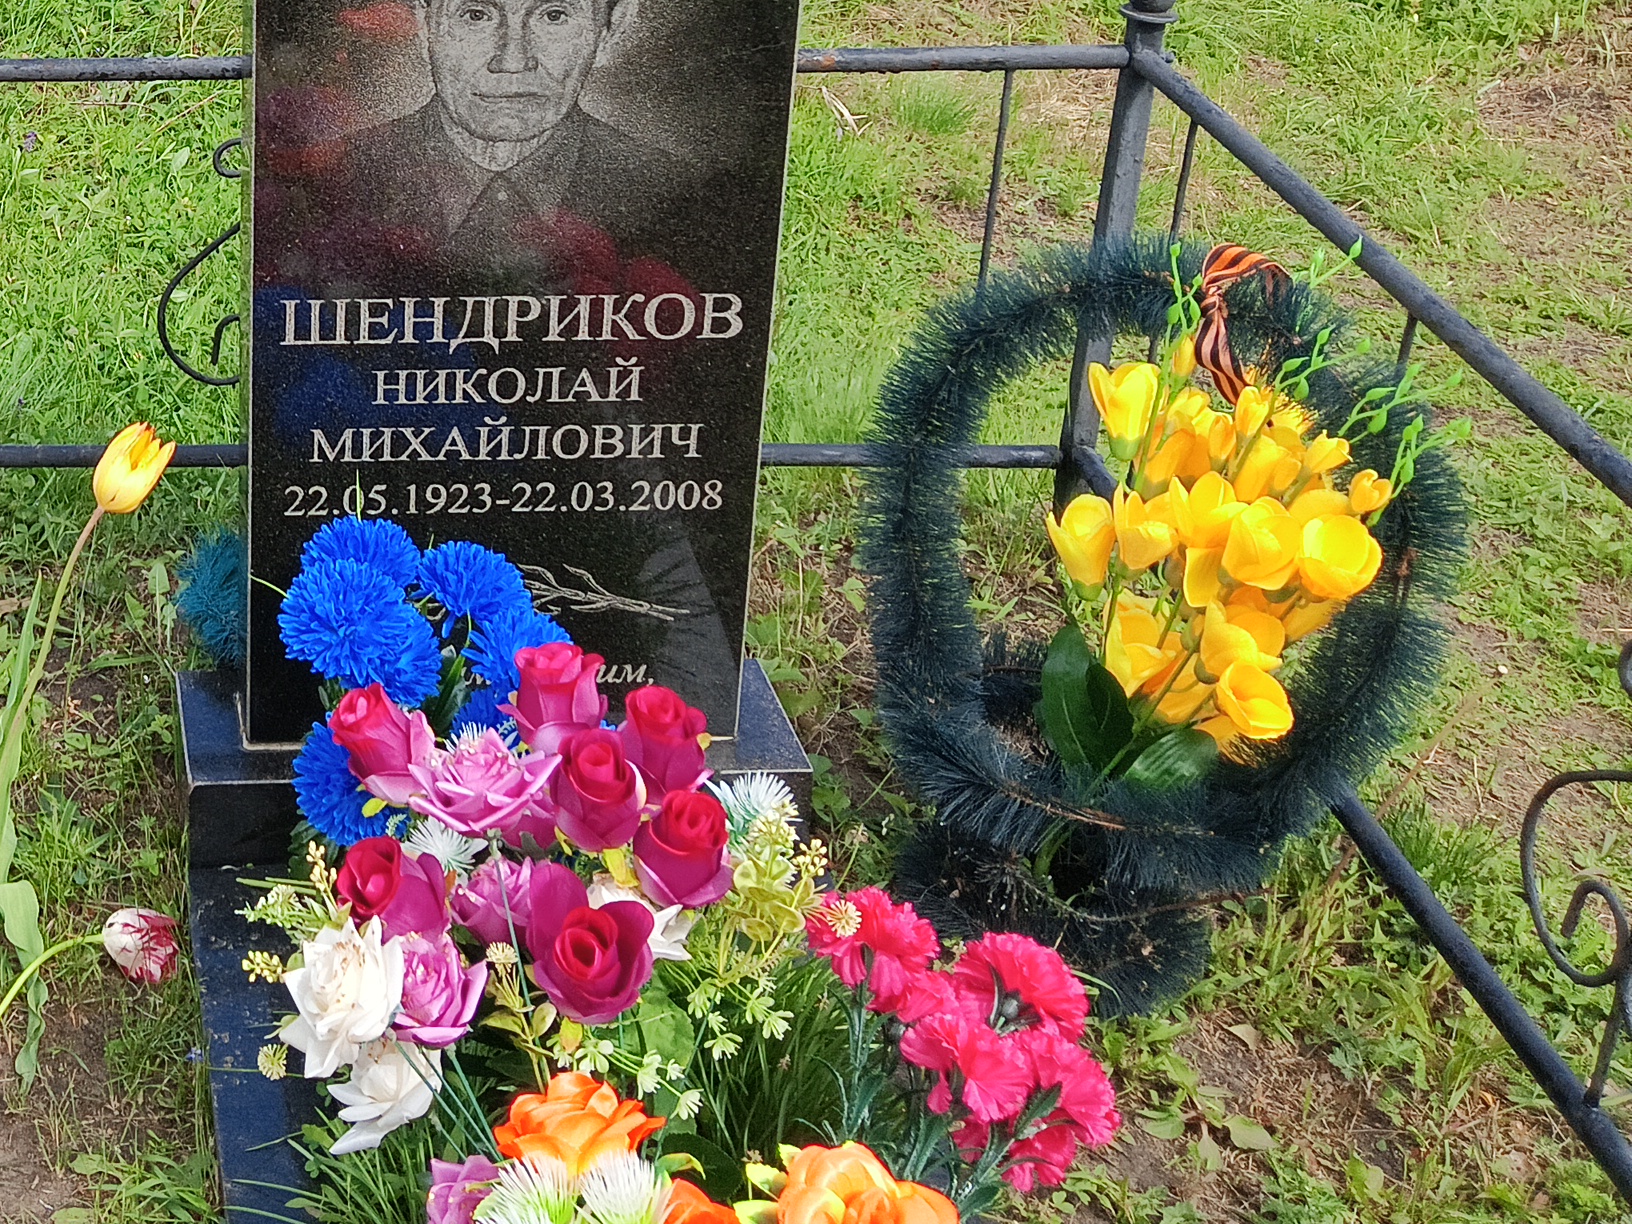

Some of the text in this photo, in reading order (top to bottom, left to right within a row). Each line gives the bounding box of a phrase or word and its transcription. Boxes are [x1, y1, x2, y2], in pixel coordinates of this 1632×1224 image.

[279, 292, 745, 355] ШЕНДРИКОВ
[371, 356, 645, 405] НИКОЛАЙ
[308, 416, 706, 464] МИХАЙЛОВИЧ
[282, 478, 725, 517] 22.05.1923-22.03.2008
